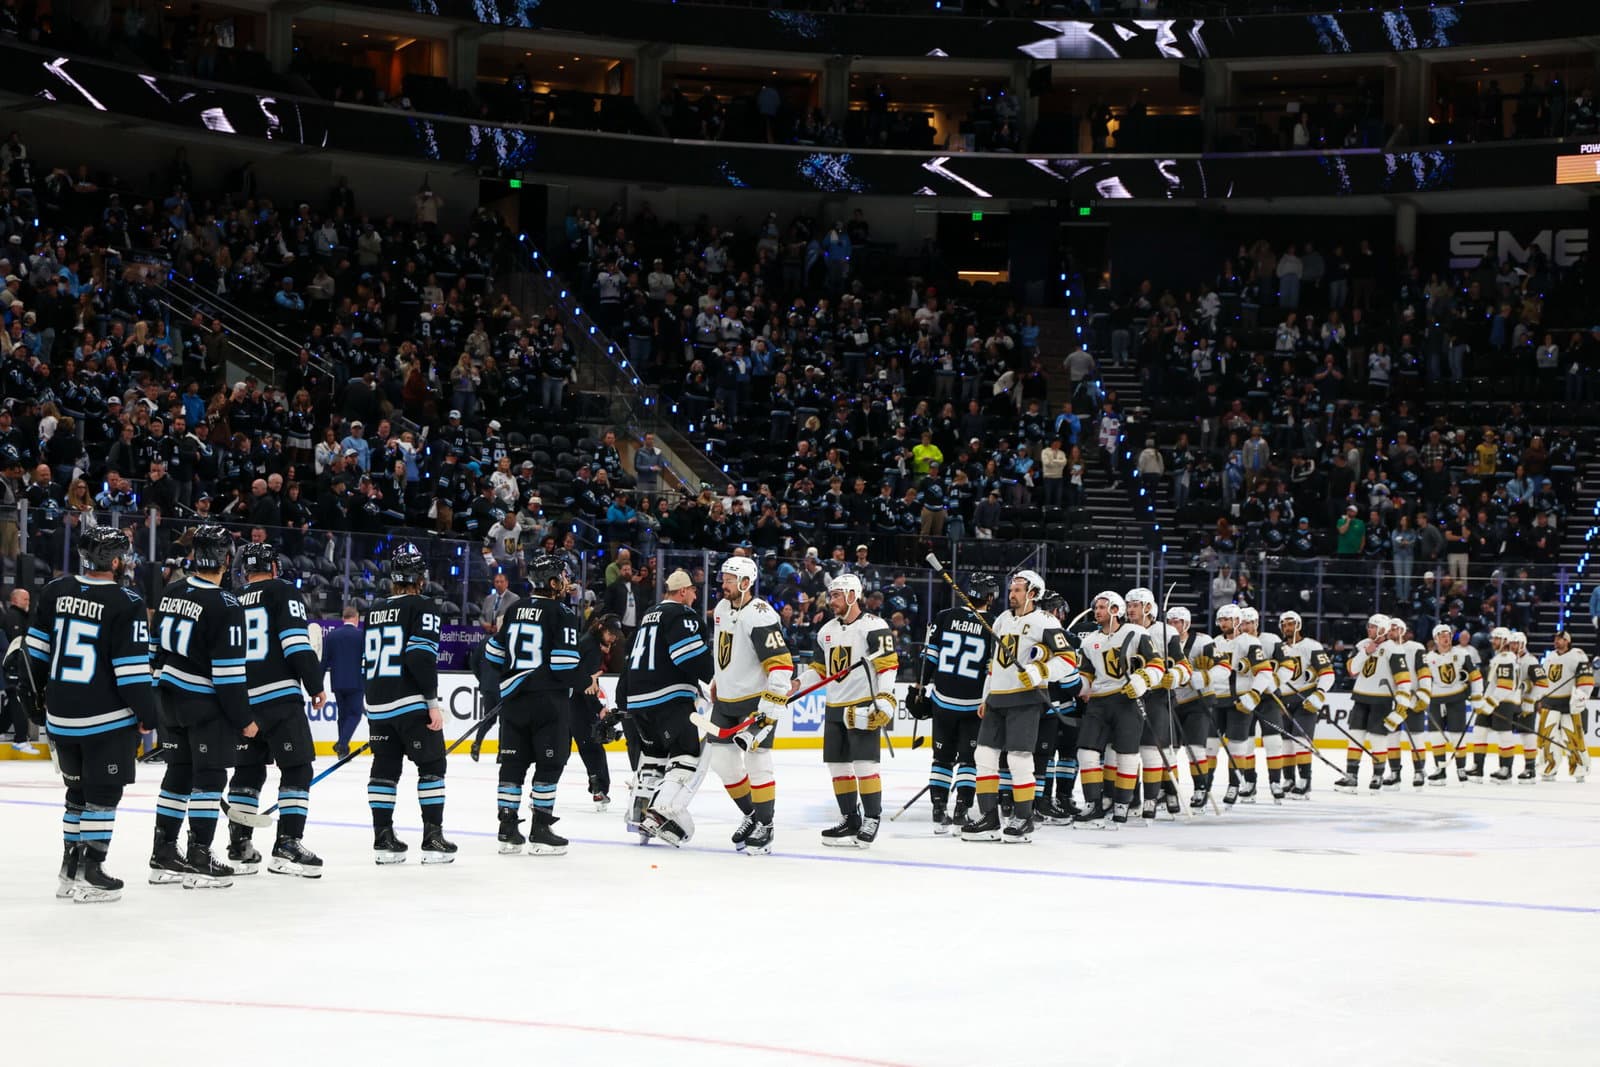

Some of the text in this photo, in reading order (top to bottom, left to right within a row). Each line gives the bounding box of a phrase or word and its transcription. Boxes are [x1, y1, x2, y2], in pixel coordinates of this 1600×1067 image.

[288, 600, 307, 620] 88
[369, 609, 400, 624] COOLEY
[516, 607, 542, 622] TANEV
[133, 620, 149, 642] 15
[244, 606, 269, 660] 8
[422, 613, 441, 634] 92
[950, 619, 983, 636] McBAIN
[1021, 623, 1031, 636] C
[160, 615, 194, 657] 11
[229, 626, 242, 646] 11
[507, 622, 544, 669] 13
[563, 627, 577, 646] 13
[877, 634, 894, 652] 19
[51, 617, 101, 683] 15
[365, 625, 404, 681] 92
[630, 624, 658, 671] 41
[937, 631, 986, 680] 22
[1497, 667, 1510, 677] 15
